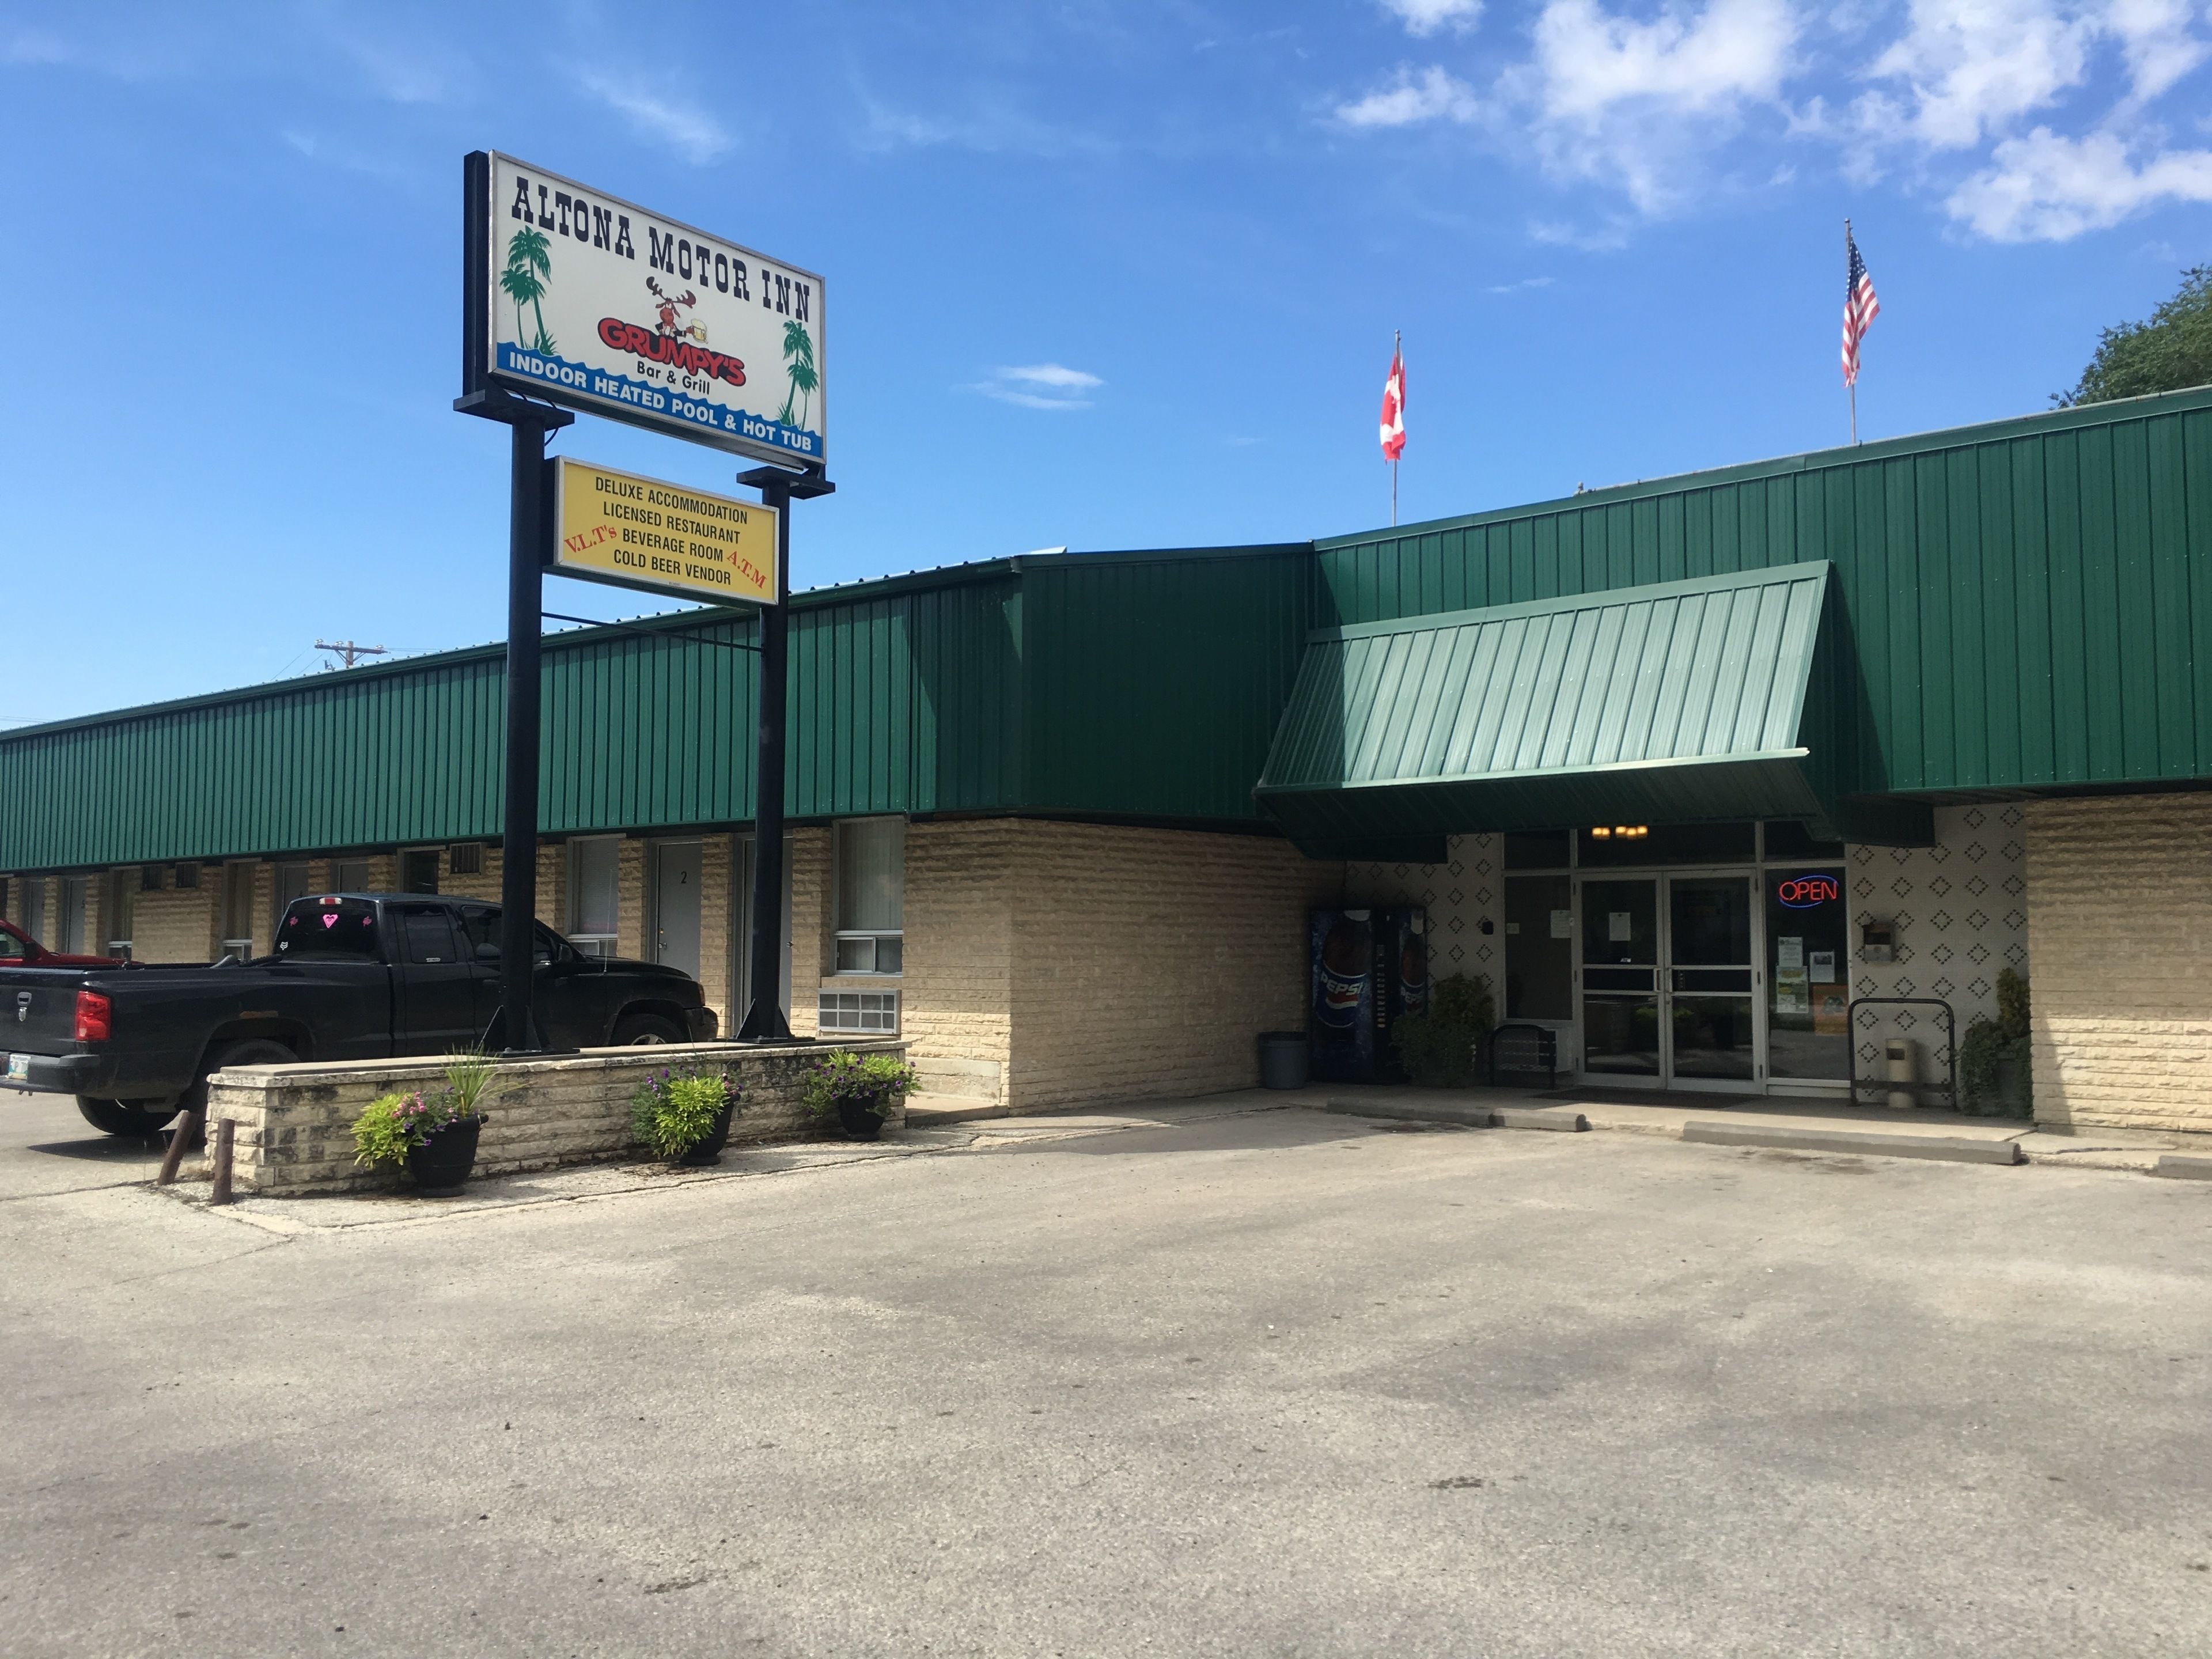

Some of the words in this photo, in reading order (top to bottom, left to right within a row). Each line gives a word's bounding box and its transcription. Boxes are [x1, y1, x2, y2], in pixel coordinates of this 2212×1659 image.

[512, 176, 635, 260] ALTONA
[649, 226, 750, 302] MOTOR
[762, 269, 810, 323] INN
[598, 317, 746, 387] GRUMPY'S
[637, 361, 661, 379] Bar
[666, 370, 676, 384] &
[682, 376, 710, 395] Grill
[509, 351, 586, 388] INDOOR
[594, 376, 665, 409] HEATED
[672, 398, 718, 425] POOL
[725, 414, 736, 430] &
[743, 419, 776, 441] HOT
[781, 430, 812, 451] TUB
[596, 476, 643, 501] DELUXE
[648, 489, 748, 524] ACCOMMODATION
[604, 501, 661, 527] LICENSED
[667, 515, 740, 544] RESTAURANT
[623, 528, 685, 554] BEVERAGE
[690, 542, 723, 562] ROOM
[614, 549, 646, 568] COLD
[652, 556, 681, 575] BEER
[685, 563, 731, 585] VENDOR
[726, 550, 767, 589] A.T.M
[681, 870, 687, 884] 2
[1778, 881, 1837, 900] OPEN
[1320, 971, 1364, 996] PEPSI
